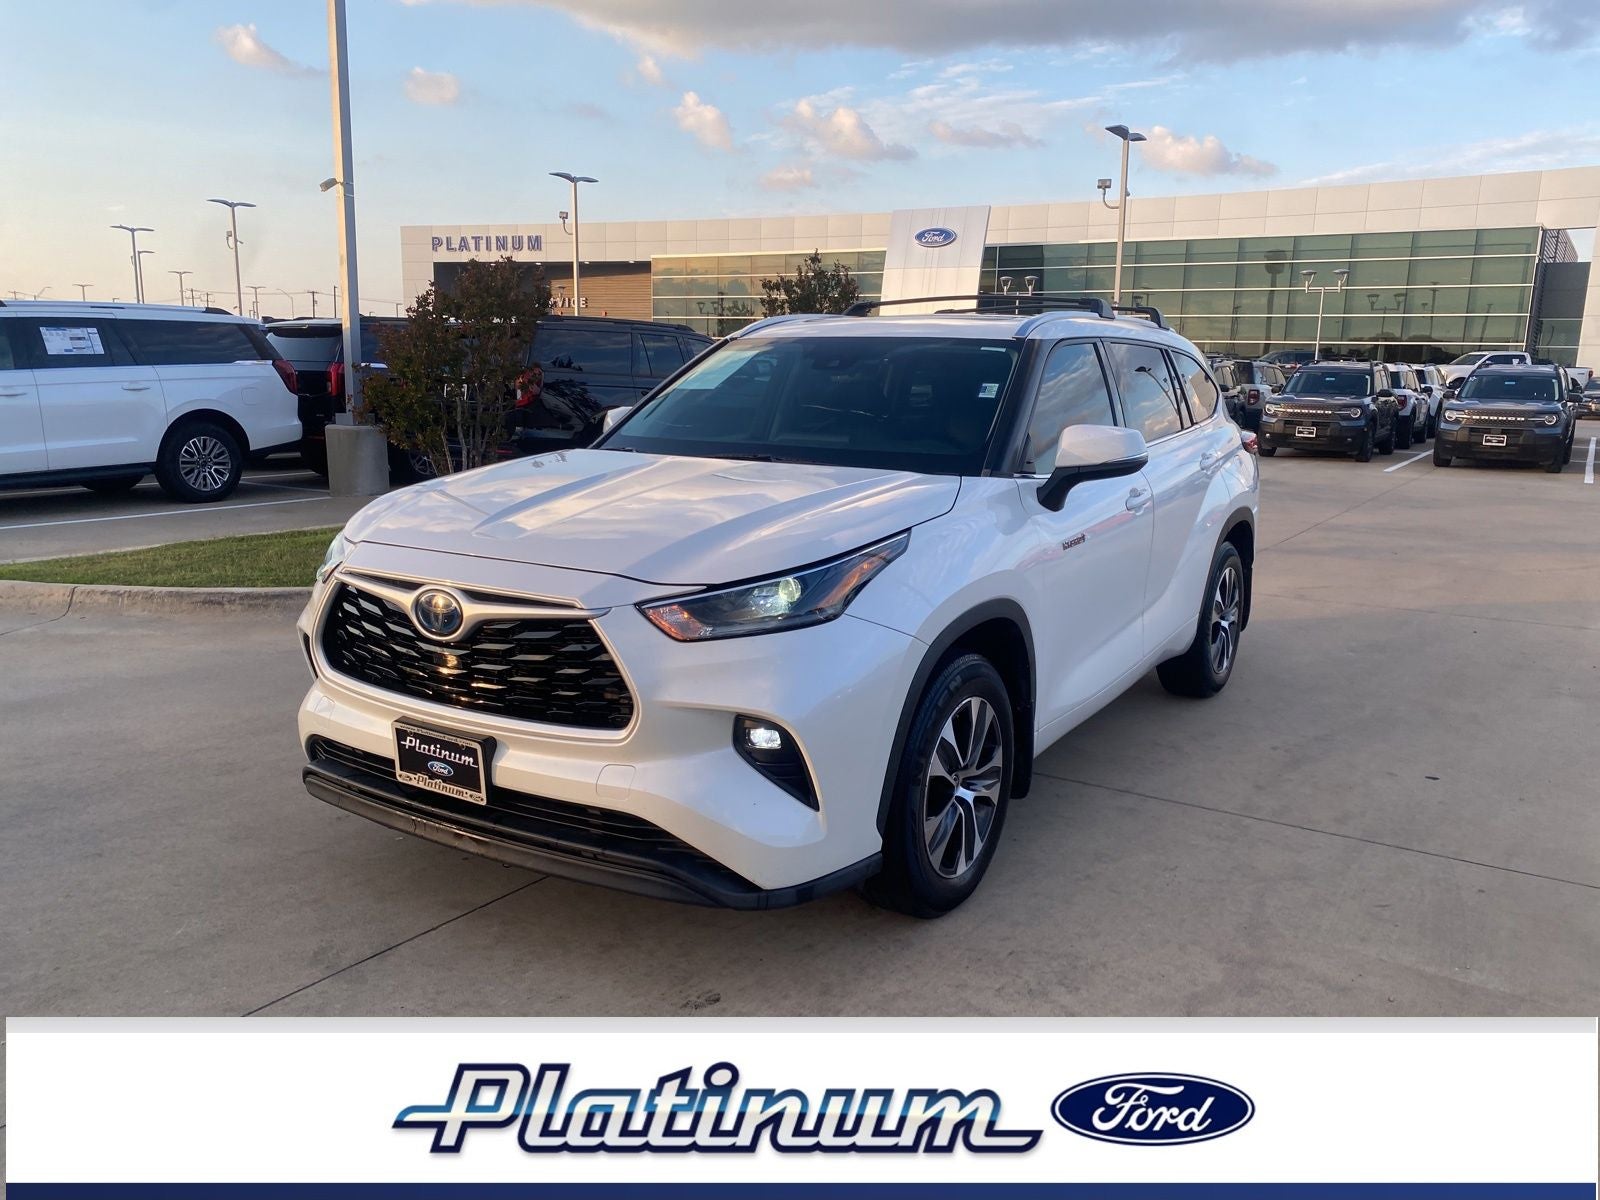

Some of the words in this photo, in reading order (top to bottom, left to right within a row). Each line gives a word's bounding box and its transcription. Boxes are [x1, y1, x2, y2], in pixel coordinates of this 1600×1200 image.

[432, 235, 543, 252] PLATINUM
[921, 231, 946, 242] Ford
[401, 736, 478, 768] Platinum
[417, 773, 465, 797] Platinum
